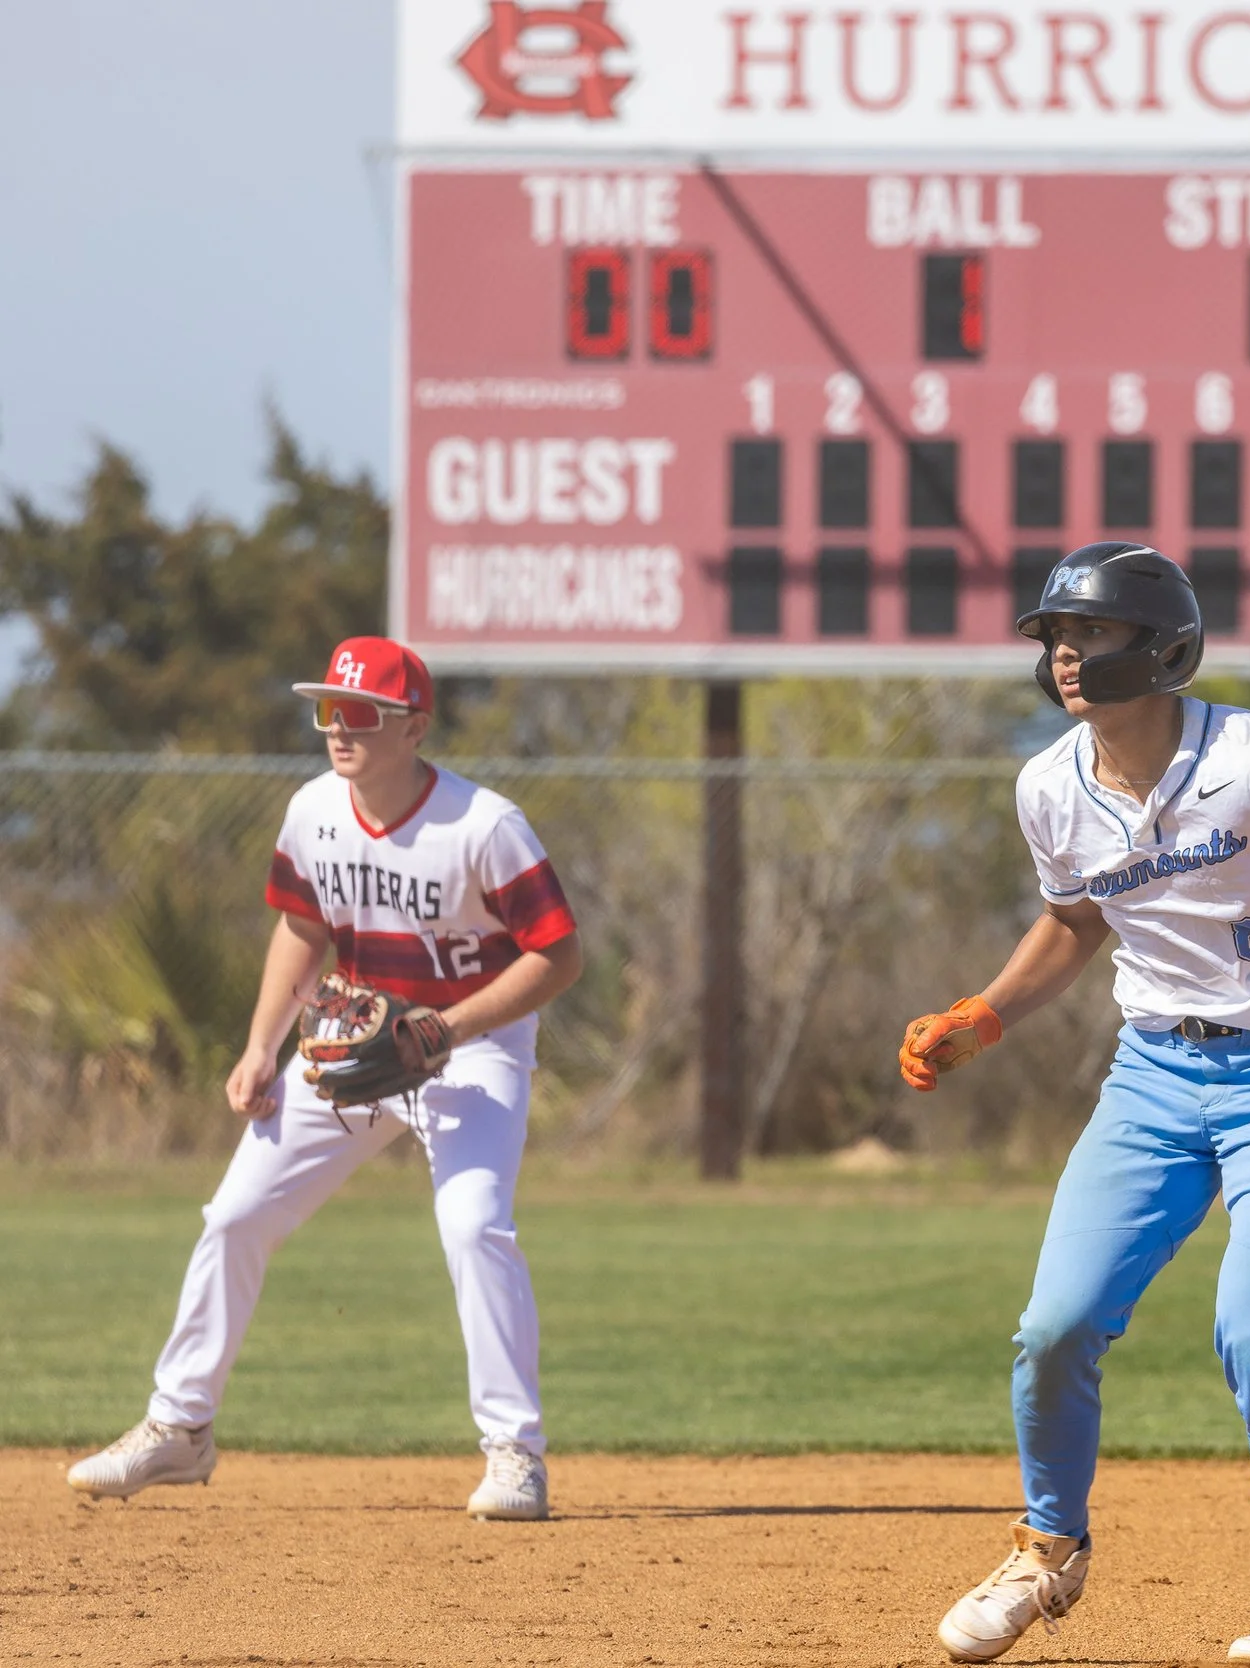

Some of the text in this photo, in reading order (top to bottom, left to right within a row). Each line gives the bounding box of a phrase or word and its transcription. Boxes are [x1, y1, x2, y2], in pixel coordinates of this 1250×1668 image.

[521, 177, 680, 245] TIME
[867, 178, 1039, 247] BALL
[745, 373, 774, 432] 1
[824, 373, 861, 434] 2
[912, 372, 949, 432] 3
[1021, 374, 1058, 431] 4
[1109, 372, 1147, 433] 5
[1195, 372, 1233, 433] 6
[427, 436, 676, 525] GUEST
[427, 543, 683, 632] HURRICANES
[316, 861, 441, 920] HATTERAS
[419, 928, 482, 980] 12
